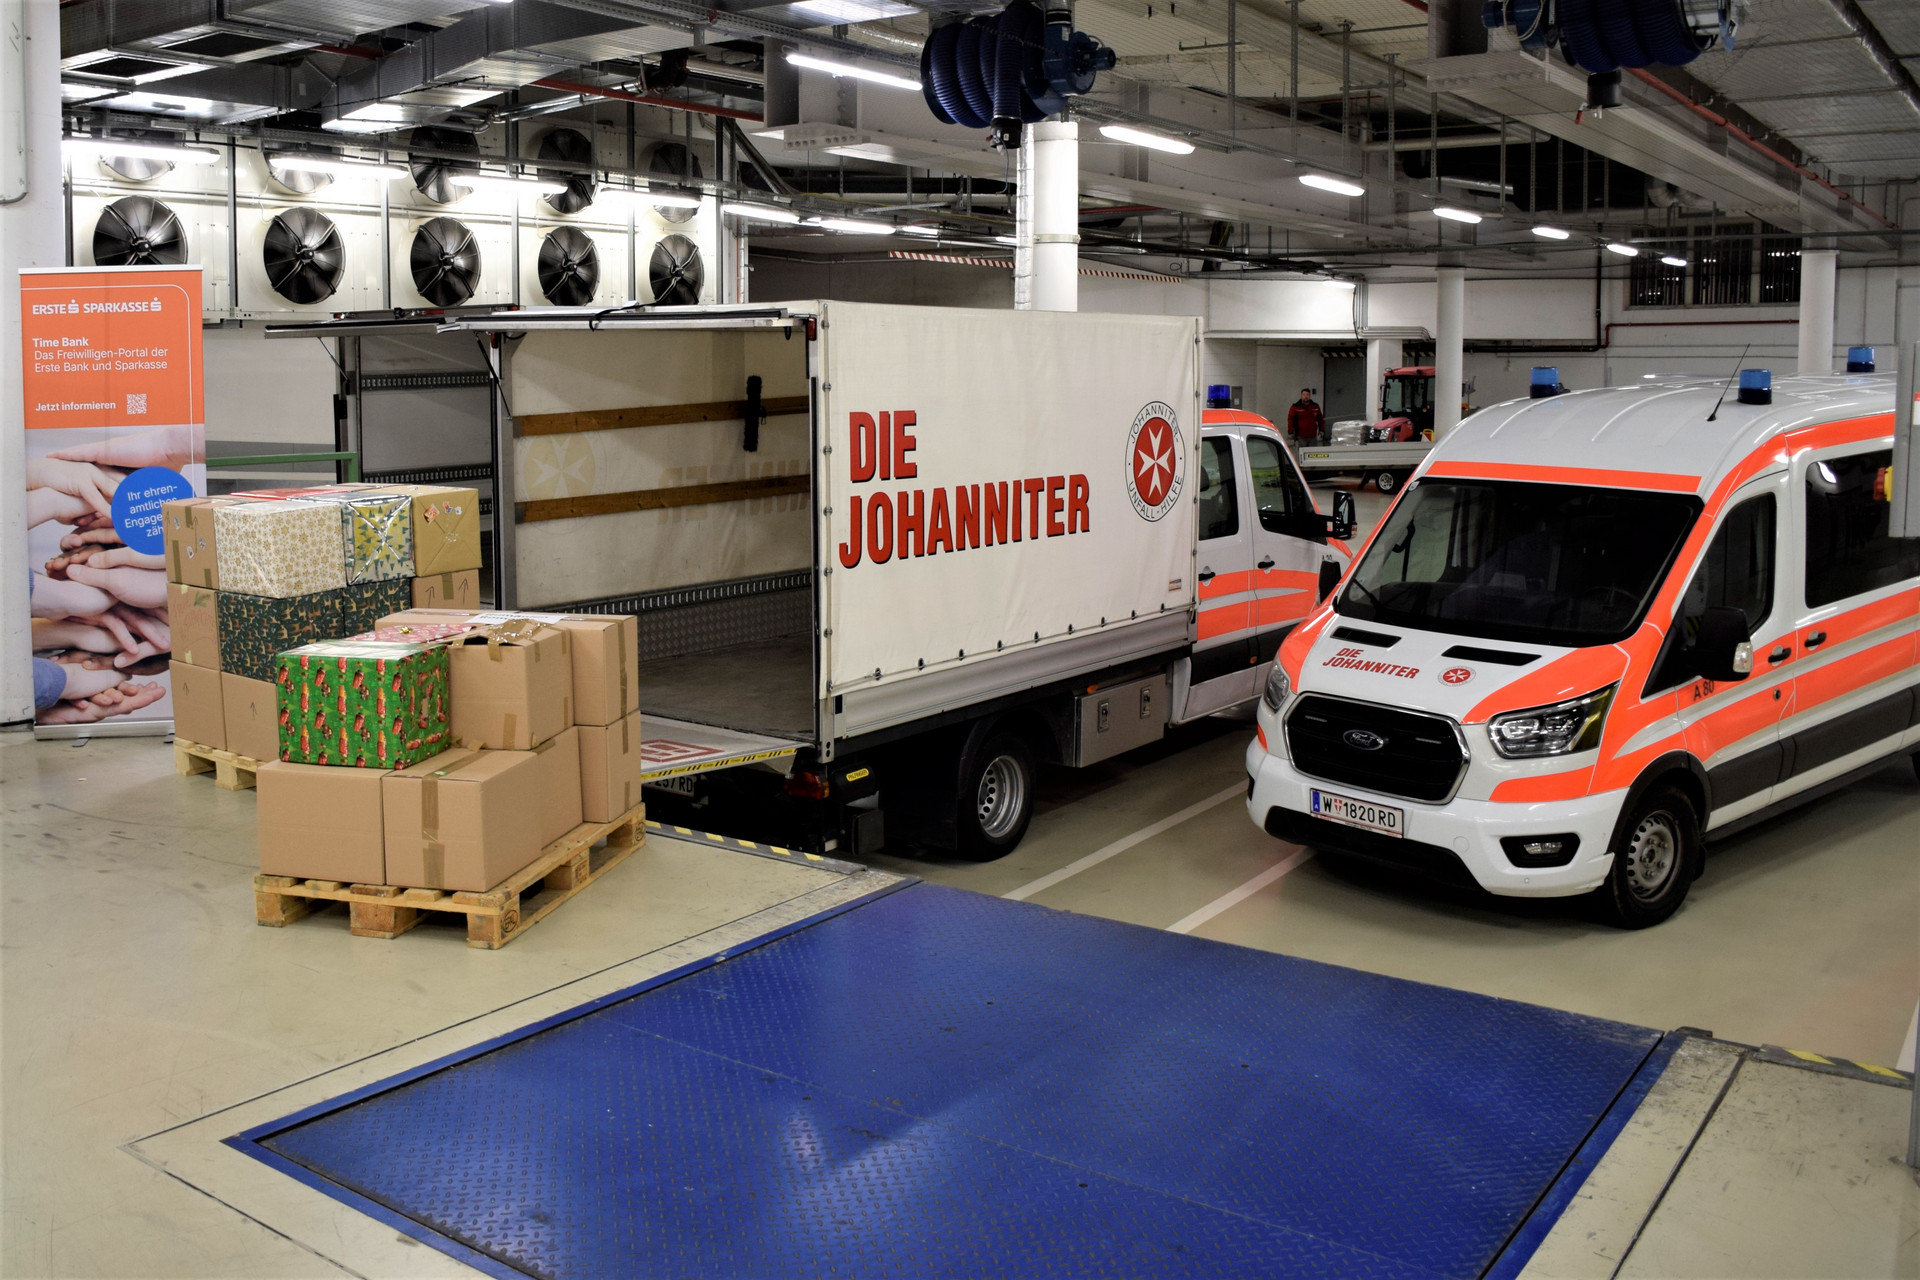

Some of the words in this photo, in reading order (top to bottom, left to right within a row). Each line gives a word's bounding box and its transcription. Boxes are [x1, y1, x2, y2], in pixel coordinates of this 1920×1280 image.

[32, 304, 66, 315] ERSTE
[83, 302, 149, 314] SPARKASSE
[32, 338, 59, 348] Time
[61, 337, 89, 347] Bank
[34, 350, 54, 360] Das
[57, 348, 148, 361] Freiwilligen-Portal
[151, 347, 168, 358] der
[35, 362, 61, 373] Erste
[63, 362, 89, 372] Bank
[92, 361, 112, 371] und
[115, 360, 168, 372] Sparkasse
[35, 402, 60, 412] Jetzt
[61, 400, 116, 410] informieren
[849, 410, 917, 483] DIE
[127, 491, 141, 502] Ihr
[144, 485, 178, 498] ehren-
[839, 473, 1090, 569] JOHANNITER
[1336, 647, 1364, 658] DIE
[1322, 656, 1420, 679] JOHANNITER
[1693, 684, 1702, 702] A
[1703, 680, 1714, 696] 80
[1323, 796, 1332, 813] W
[1343, 801, 1375, 823] 1820
[1378, 809, 1396, 828] RD
